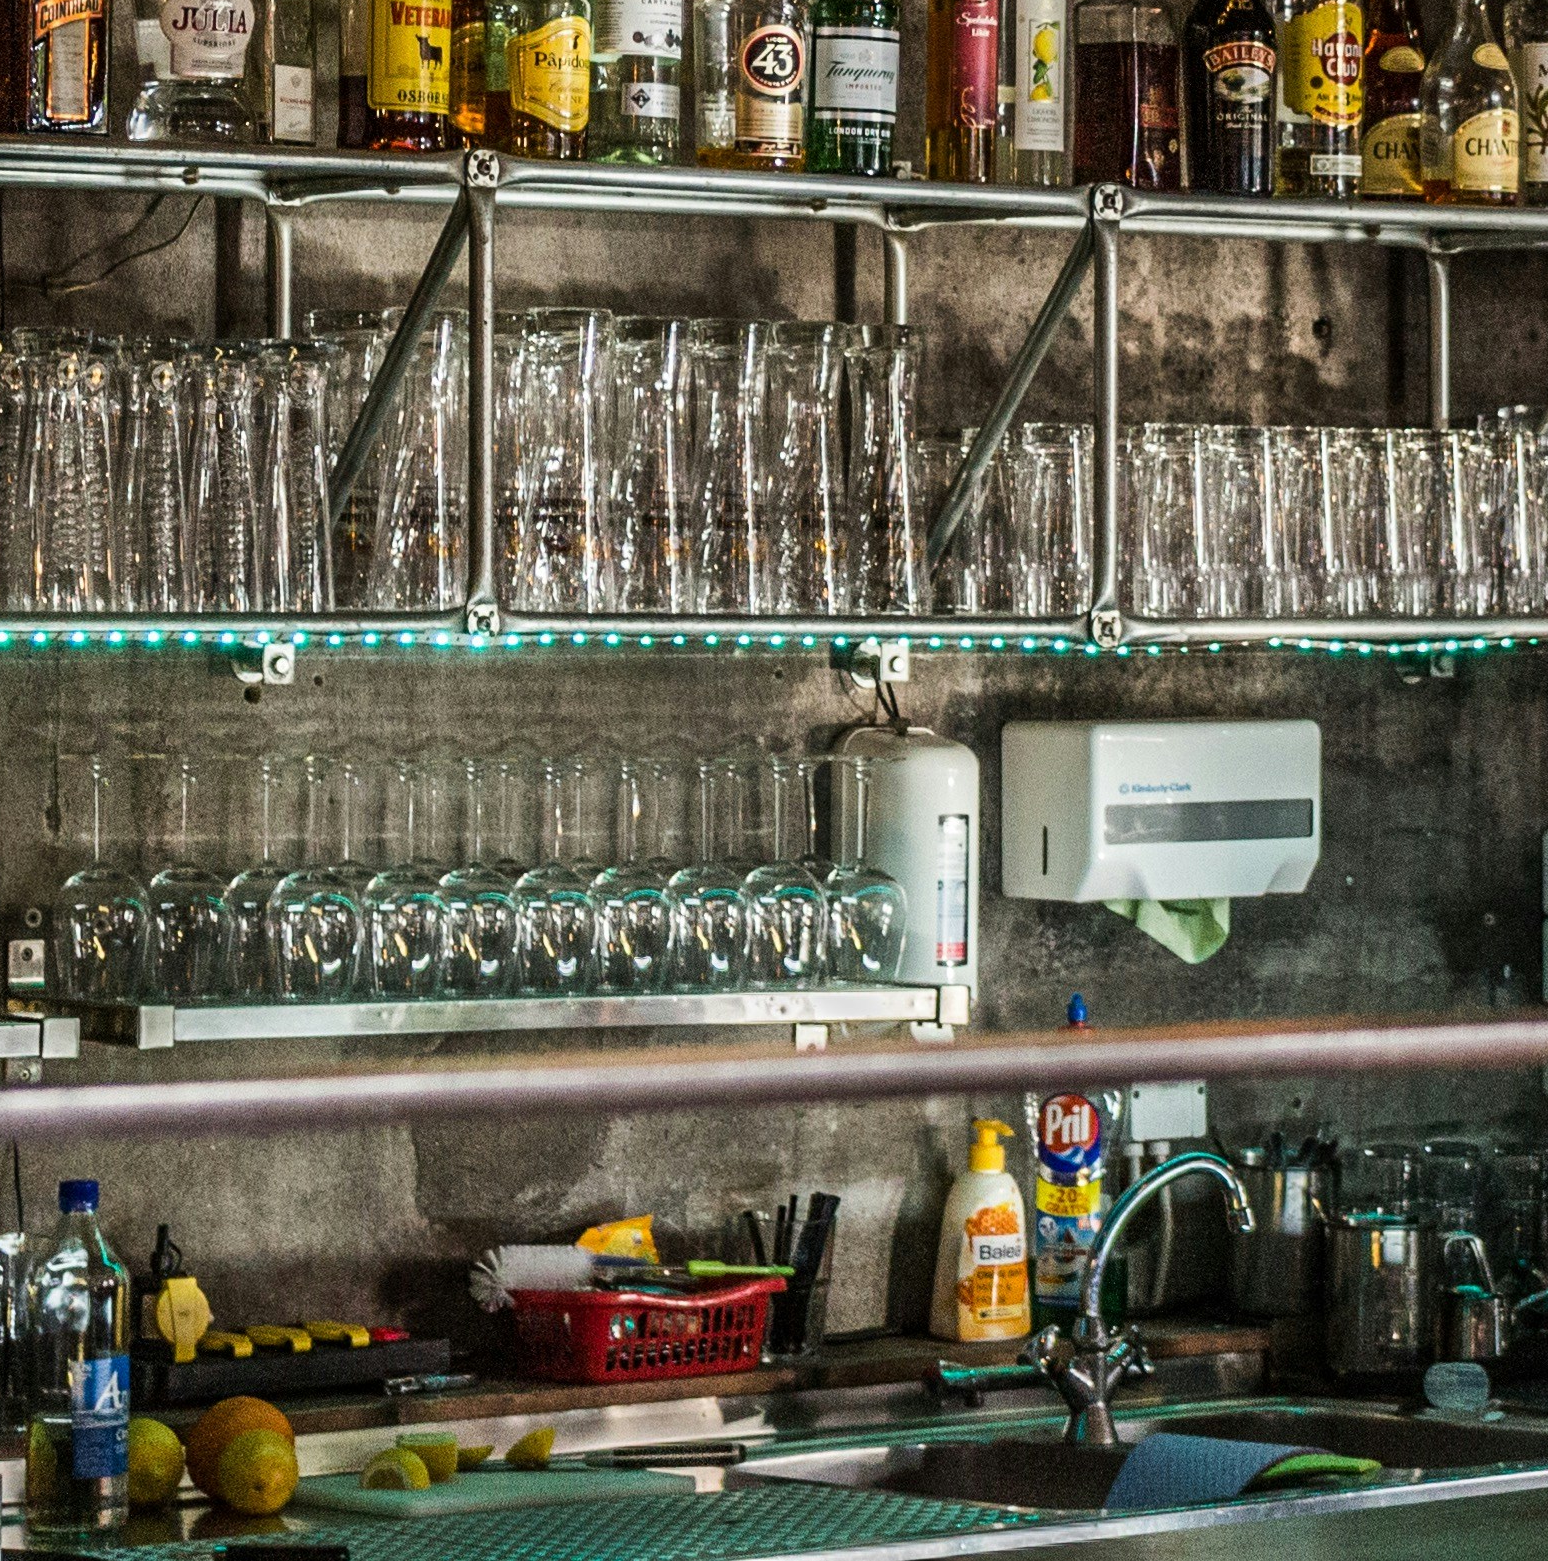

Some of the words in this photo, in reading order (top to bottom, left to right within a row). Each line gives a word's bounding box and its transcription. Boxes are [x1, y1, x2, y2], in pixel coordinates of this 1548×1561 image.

[172, 7, 248, 35] JULIA
[752, 43, 794, 77] 43
[1210, 46, 1274, 67] BAILEYS
[826, 60, 895, 85] Tanqueray
[1327, 60, 1358, 78] Club
[828, 127, 862, 136] LONDON
[1045, 1104, 1091, 1146] Pril
[979, 1244, 1022, 1262] Balea
